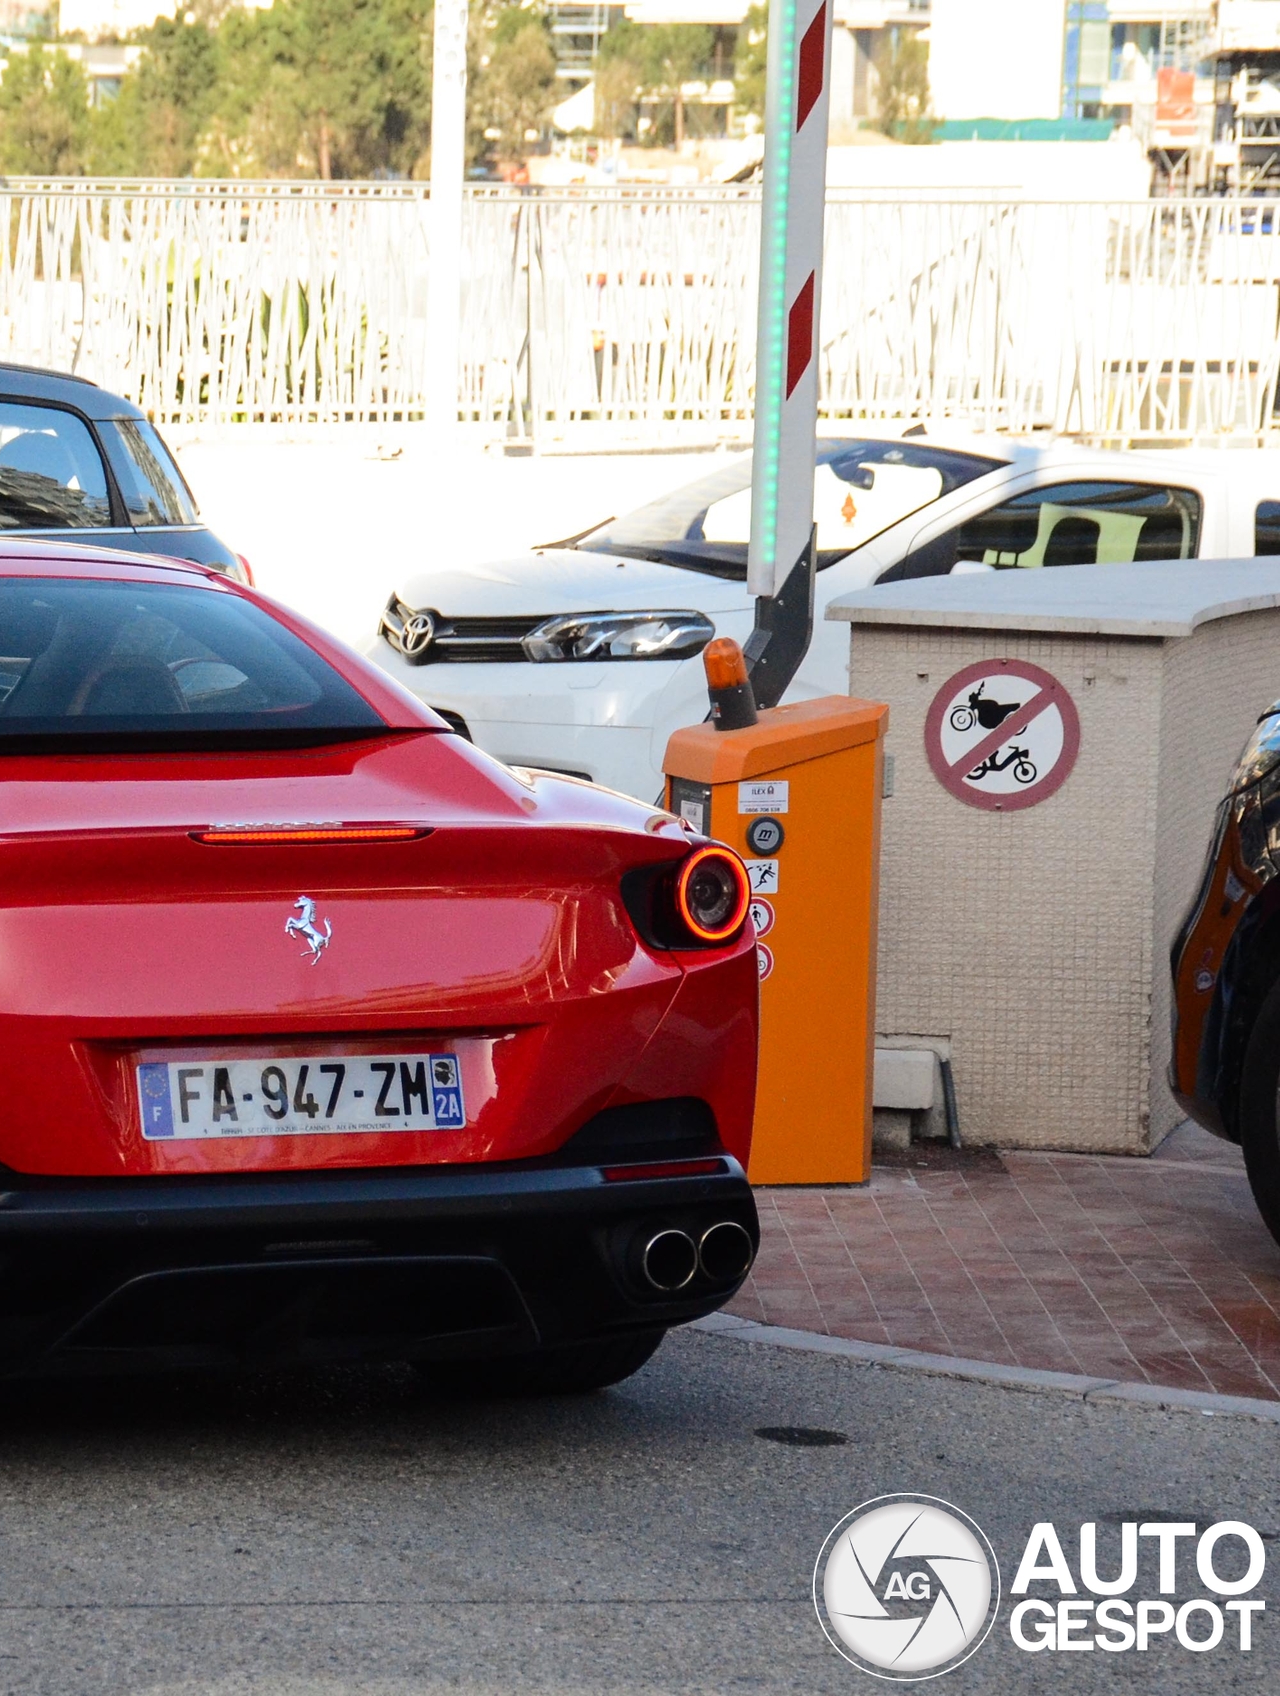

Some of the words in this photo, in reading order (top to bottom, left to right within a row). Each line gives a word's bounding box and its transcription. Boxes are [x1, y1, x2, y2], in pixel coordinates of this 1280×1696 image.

[177, 1061, 429, 1123] FA-947-ZM
[153, 1106, 162, 1121] F
[435, 1094, 460, 1119] 2A
